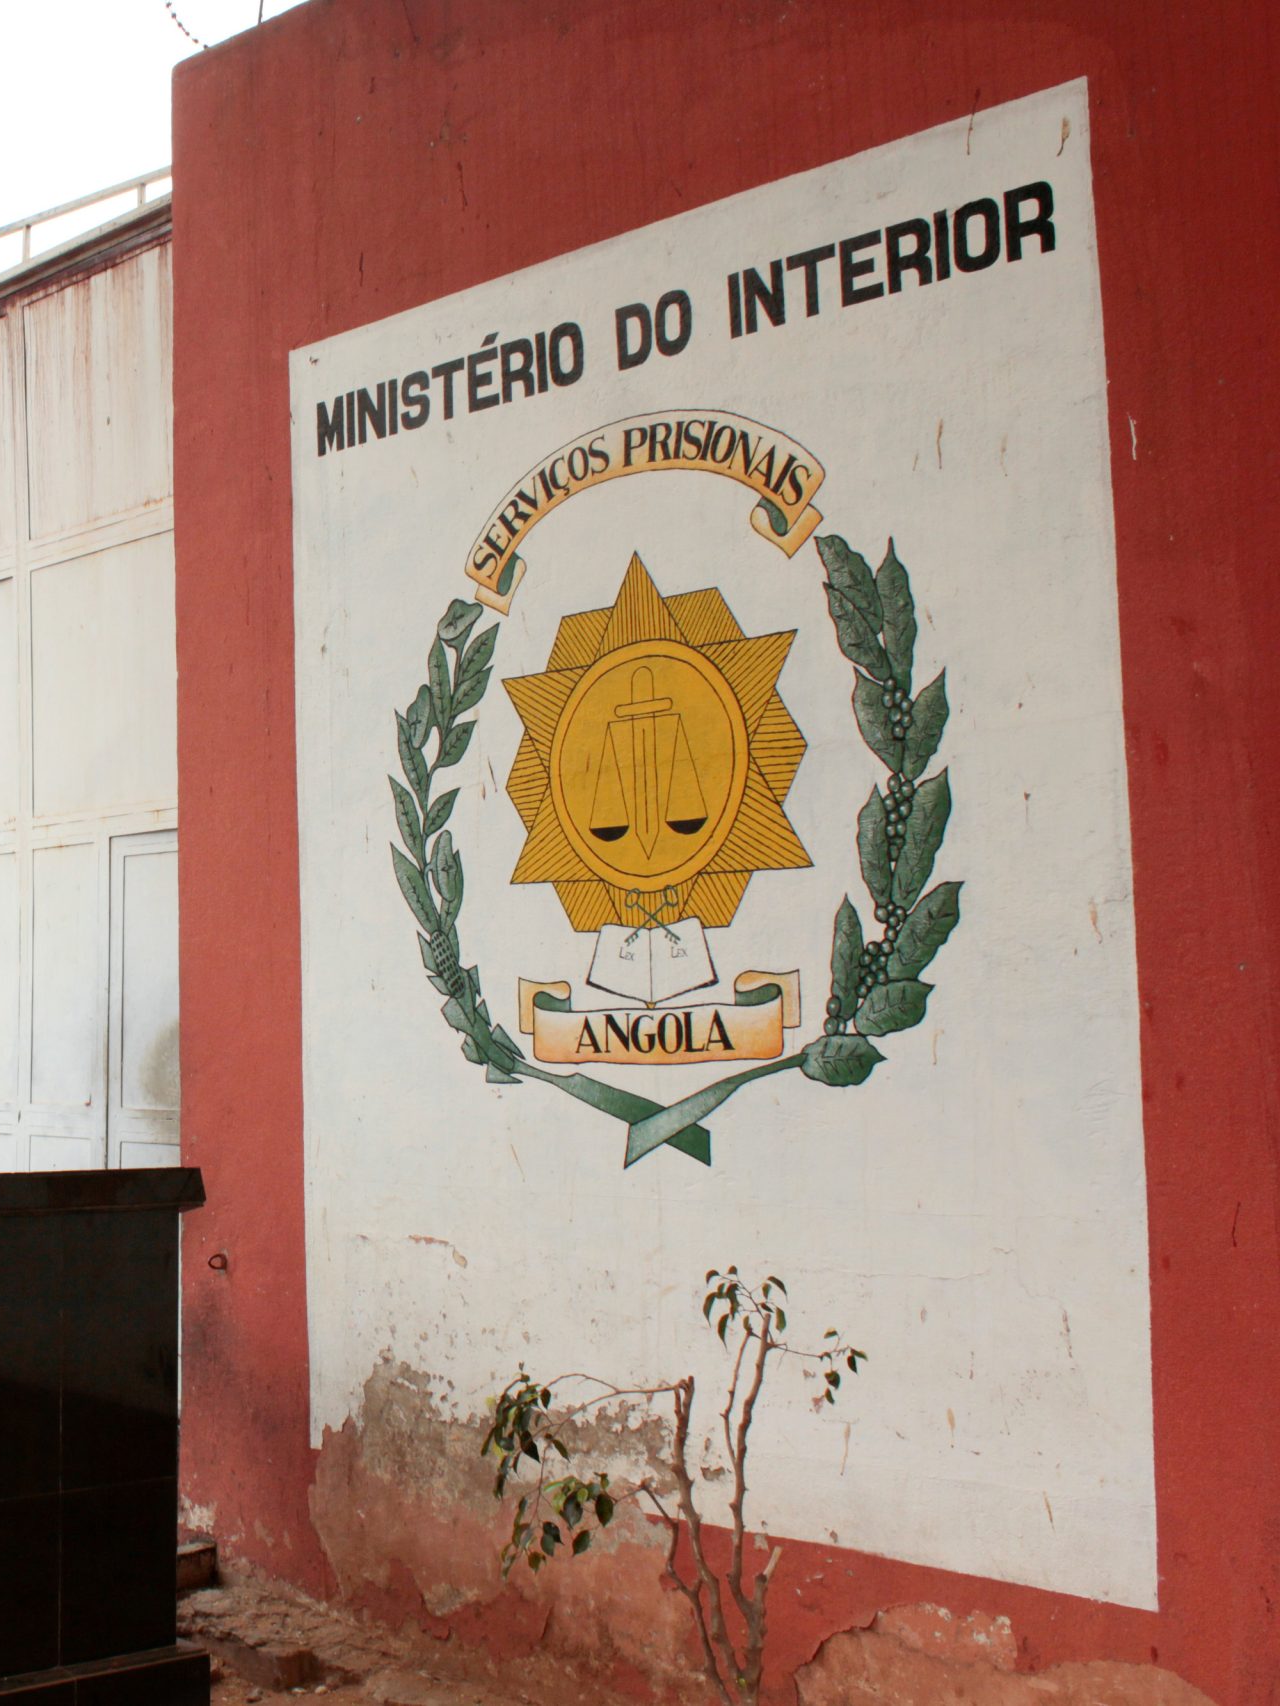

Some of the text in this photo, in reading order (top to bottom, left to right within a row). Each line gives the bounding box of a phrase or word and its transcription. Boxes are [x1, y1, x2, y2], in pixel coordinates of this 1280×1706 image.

[317, 180, 1057, 457] MINISTÉRIO DO INTERIOR
[472, 419, 812, 580] SERVIÇOS PRISIONAIS
[576, 1010, 735, 1054] ANGOLA
